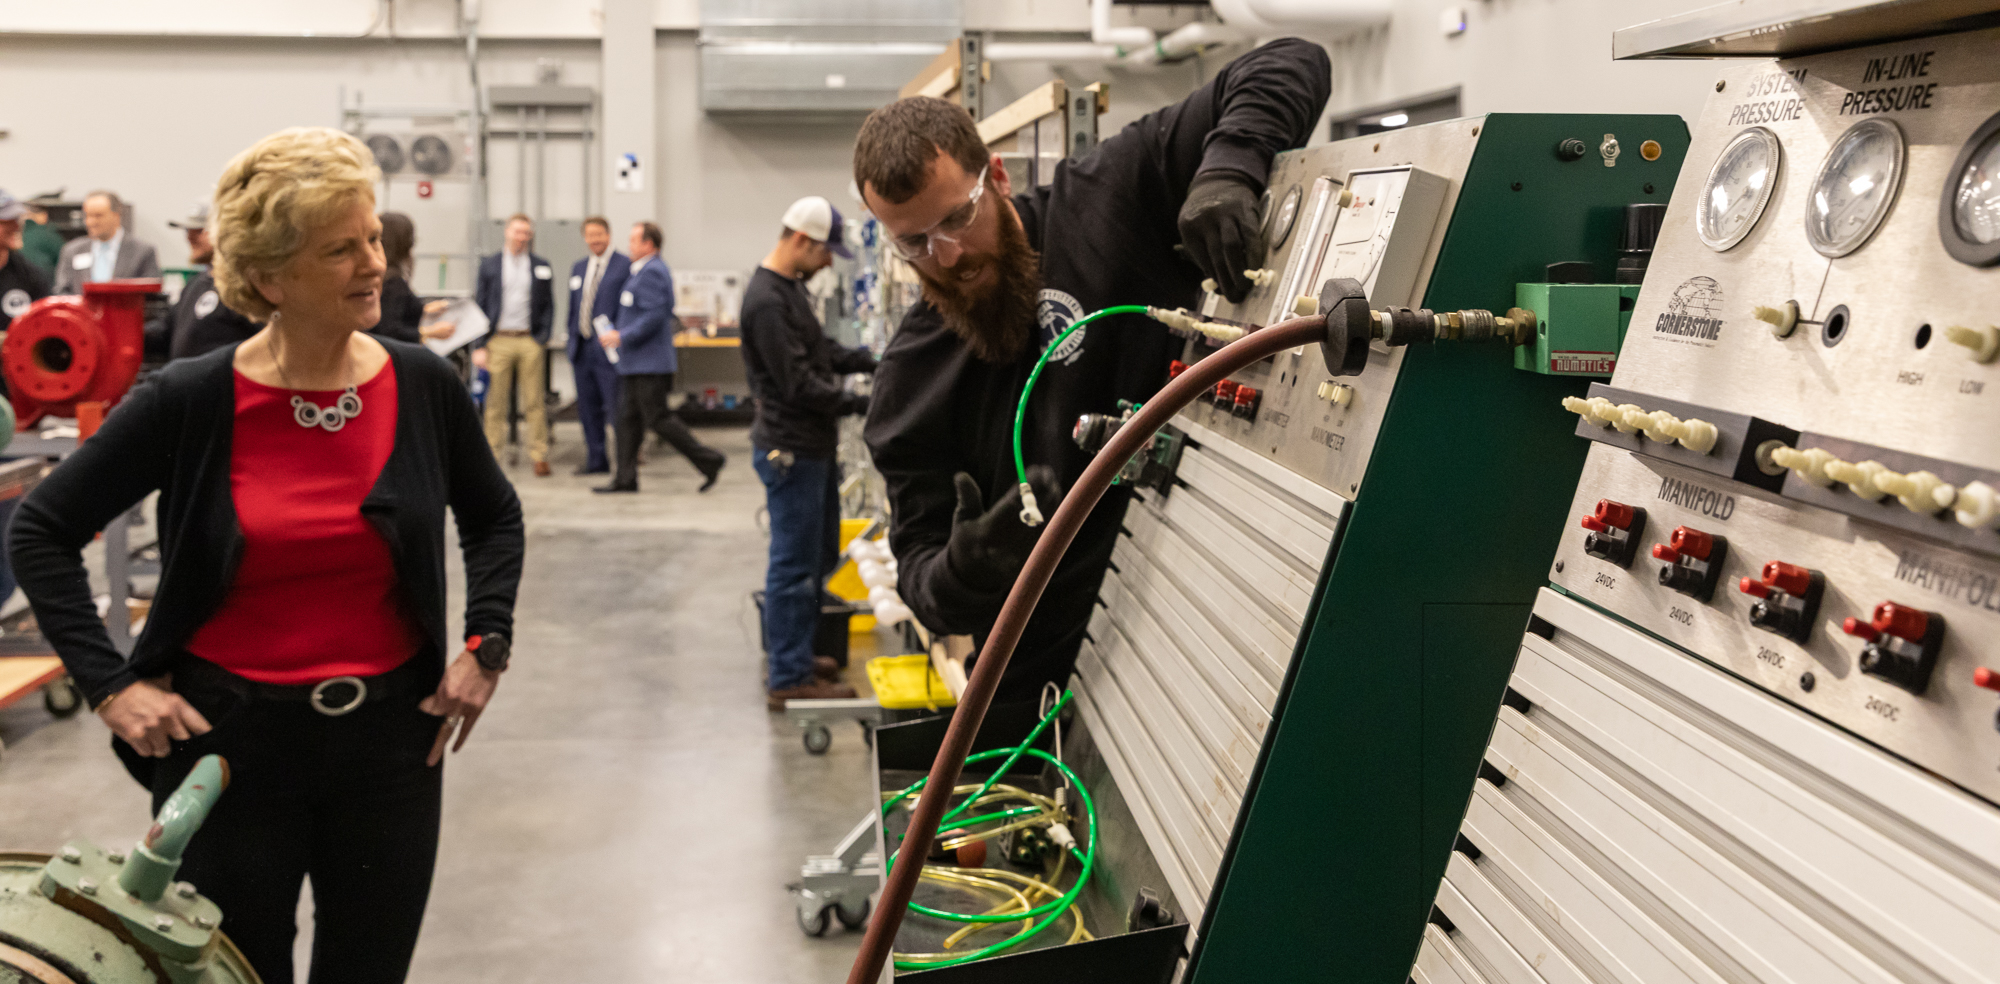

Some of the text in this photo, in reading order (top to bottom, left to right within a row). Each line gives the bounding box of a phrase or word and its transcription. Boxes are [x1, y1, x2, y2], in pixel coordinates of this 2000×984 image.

[1862, 51, 1935, 84] IN-LINE
[1747, 68, 1808, 98] SYSTEM
[1728, 98, 1806, 126] PRESSURE
[1839, 83, 1938, 116] PRESSURE
[1655, 312, 1724, 341] CORNERSTONE
[1556, 359, 1610, 372] NUMATICS
[1657, 476, 1736, 521] MANIFOLD
[1594, 571, 1616, 590] 24VDC
[1894, 549, 2000, 614] MANIFOL
[1668, 606, 1694, 626] 24VDC
[1756, 646, 1786, 669] 24VDC
[1864, 695, 1900, 722] 24VDC
